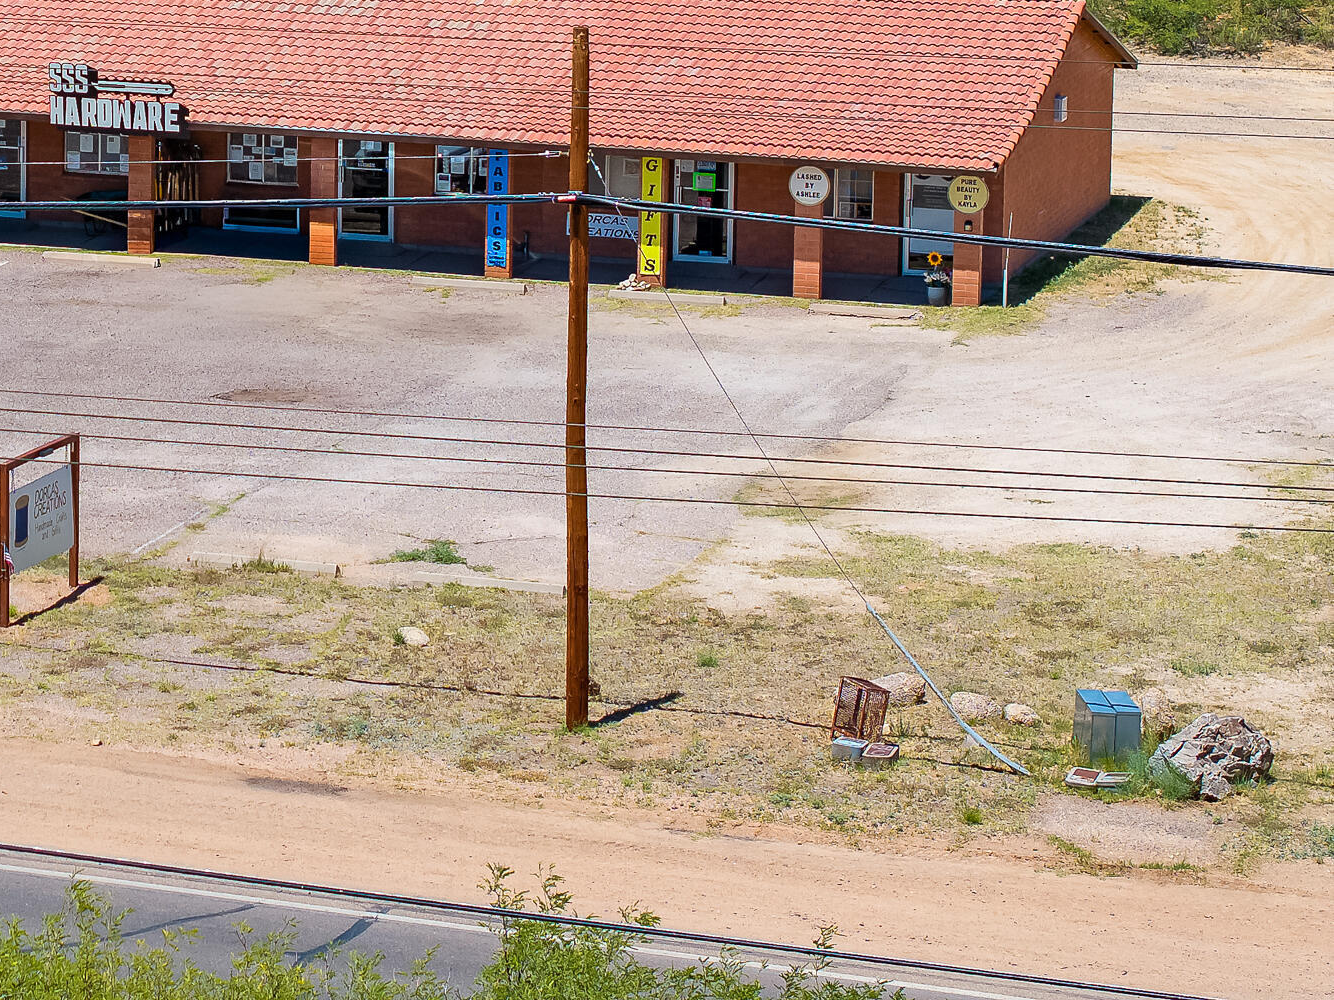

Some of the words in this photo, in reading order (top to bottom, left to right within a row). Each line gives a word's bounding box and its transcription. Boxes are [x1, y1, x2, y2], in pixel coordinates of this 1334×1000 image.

[49, 62, 89, 94] SSS
[49, 95, 180, 133] HARDWARE
[796, 173, 822, 181] LASHED
[492, 151, 504, 251] FABICS
[796, 190, 821, 198] ASHLEE
[957, 200, 978, 208] KAYLA
[587, 214, 629, 226] ORCAS
[35, 480, 58, 504] DORCAS
[34, 491, 66, 518] CREATIONS
